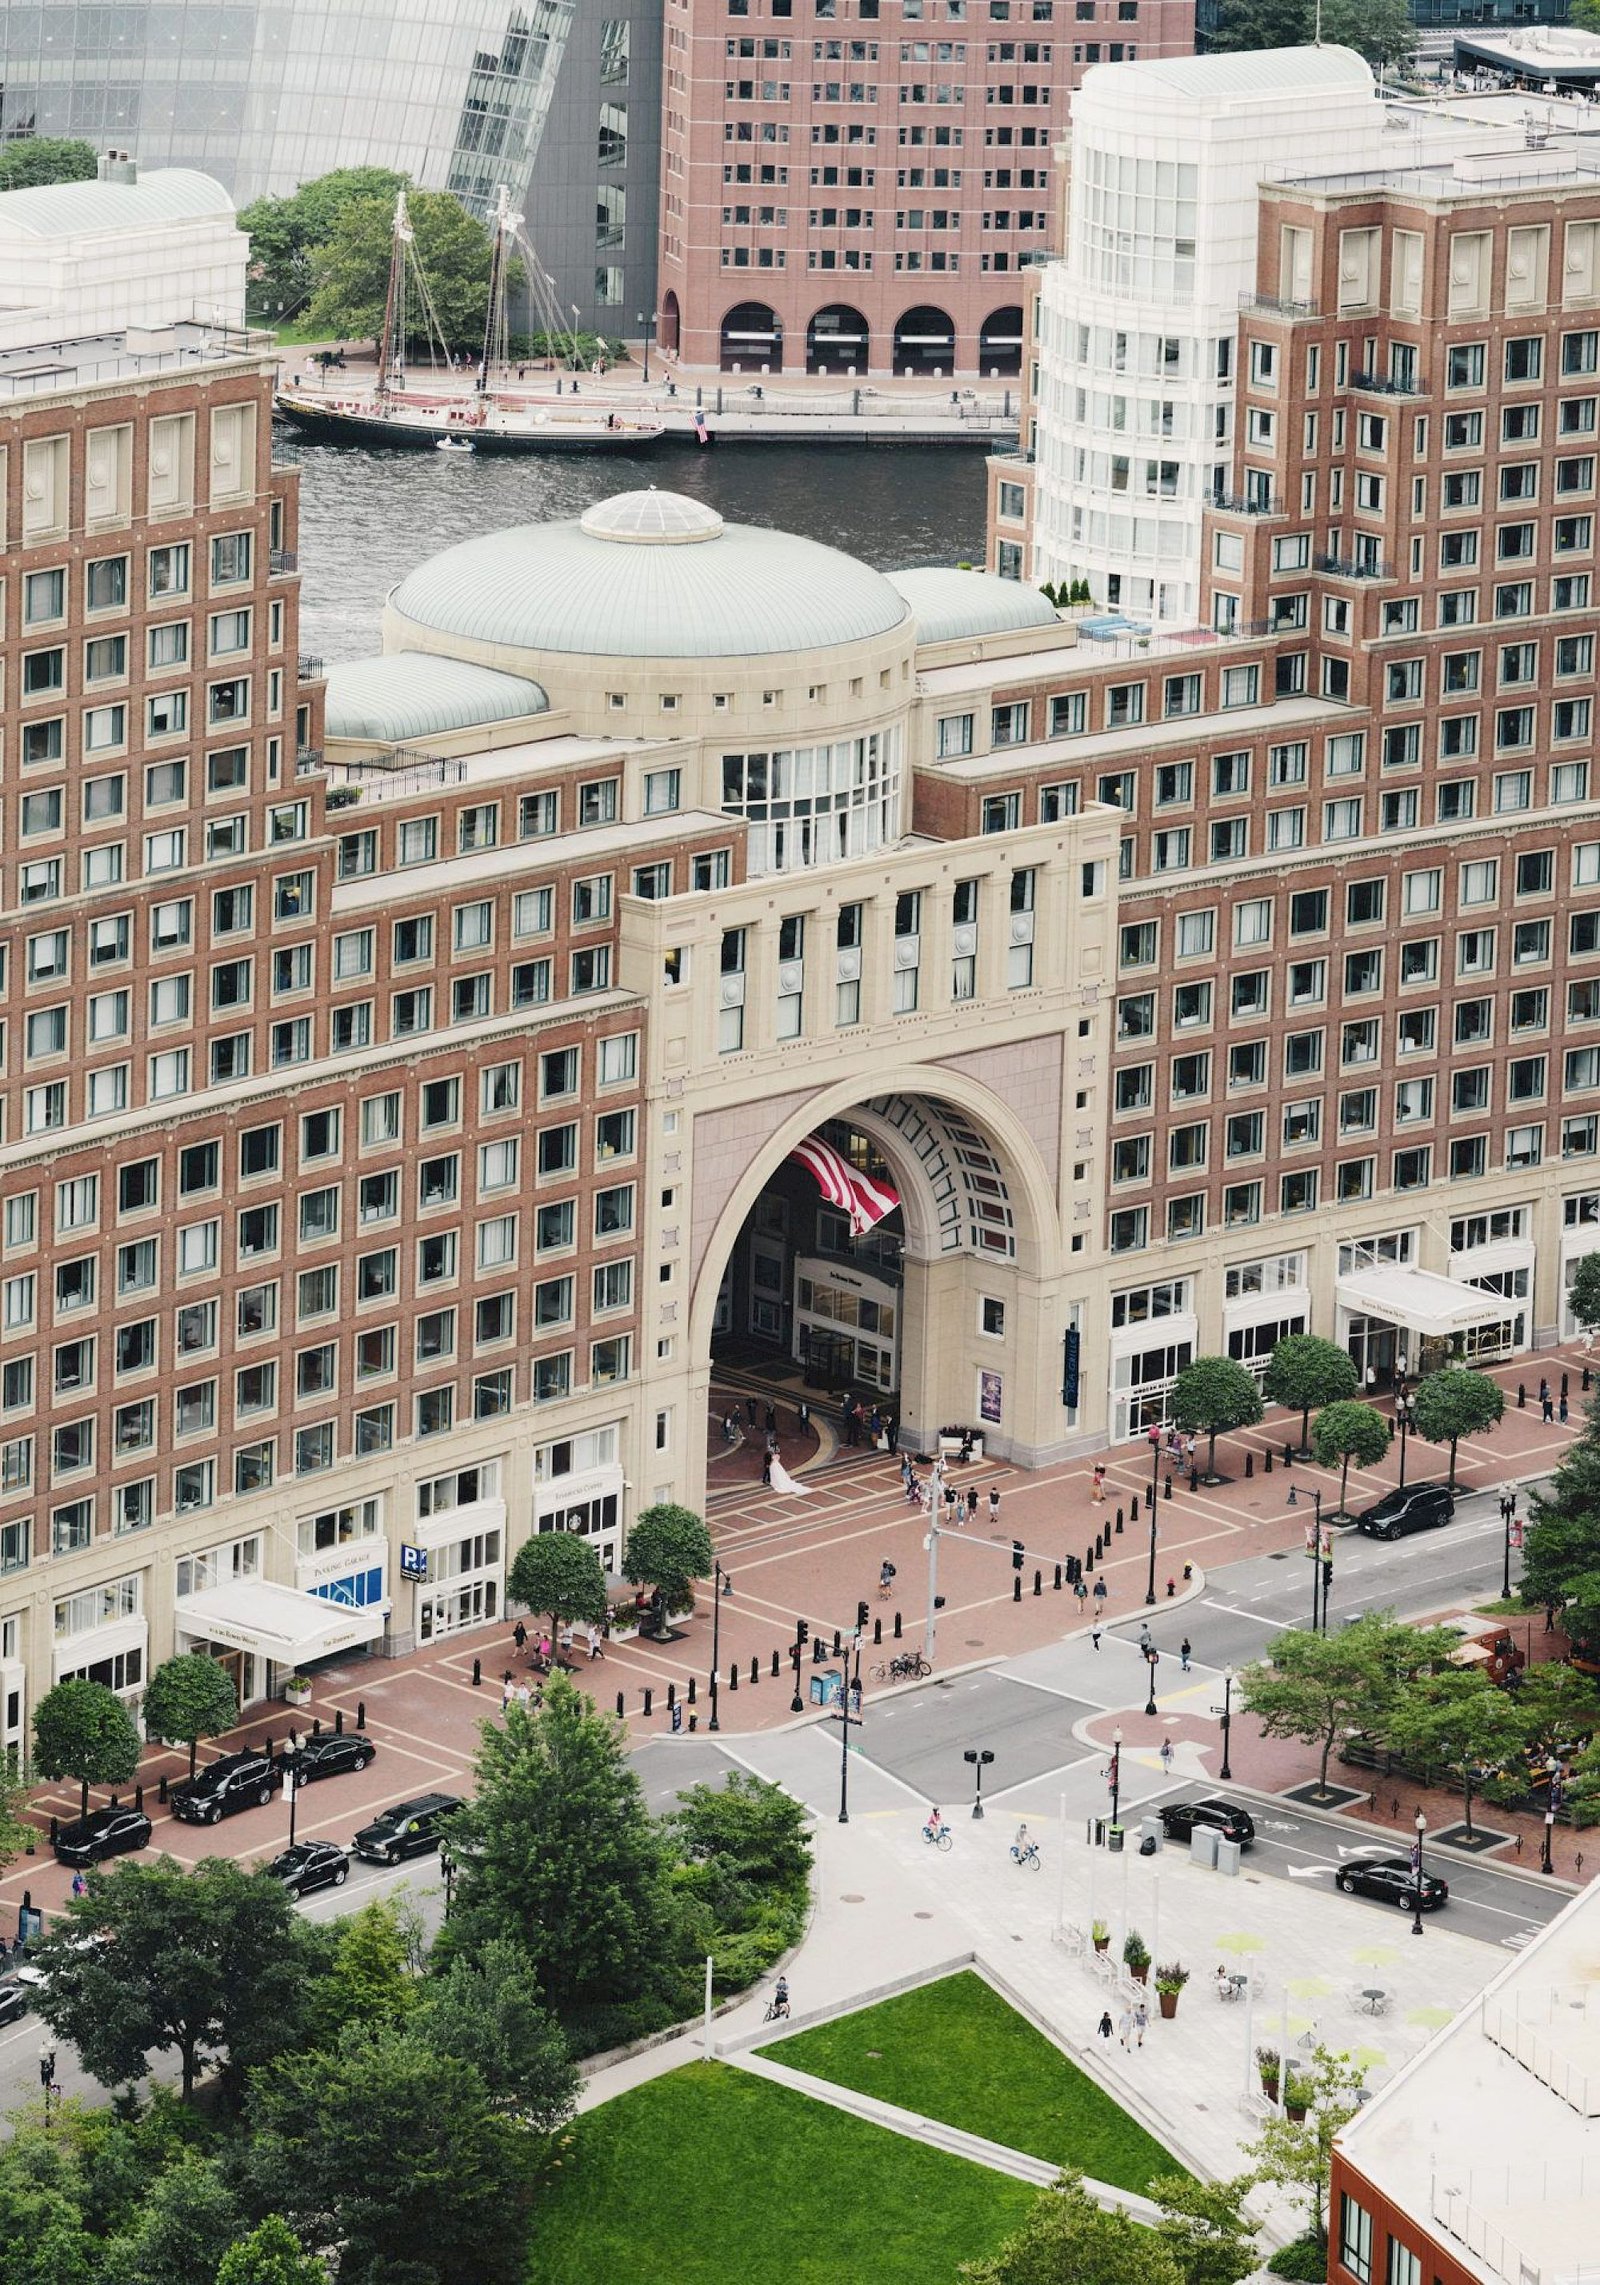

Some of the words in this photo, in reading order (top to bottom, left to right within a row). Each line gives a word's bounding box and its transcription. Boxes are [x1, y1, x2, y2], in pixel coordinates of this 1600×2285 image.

[1133, 1385, 1157, 1394] MODERN
[314, 1562, 342, 1577] PARKING
[344, 1553, 370, 1567] GARAGE
[404, 1546, 417, 1567] P
